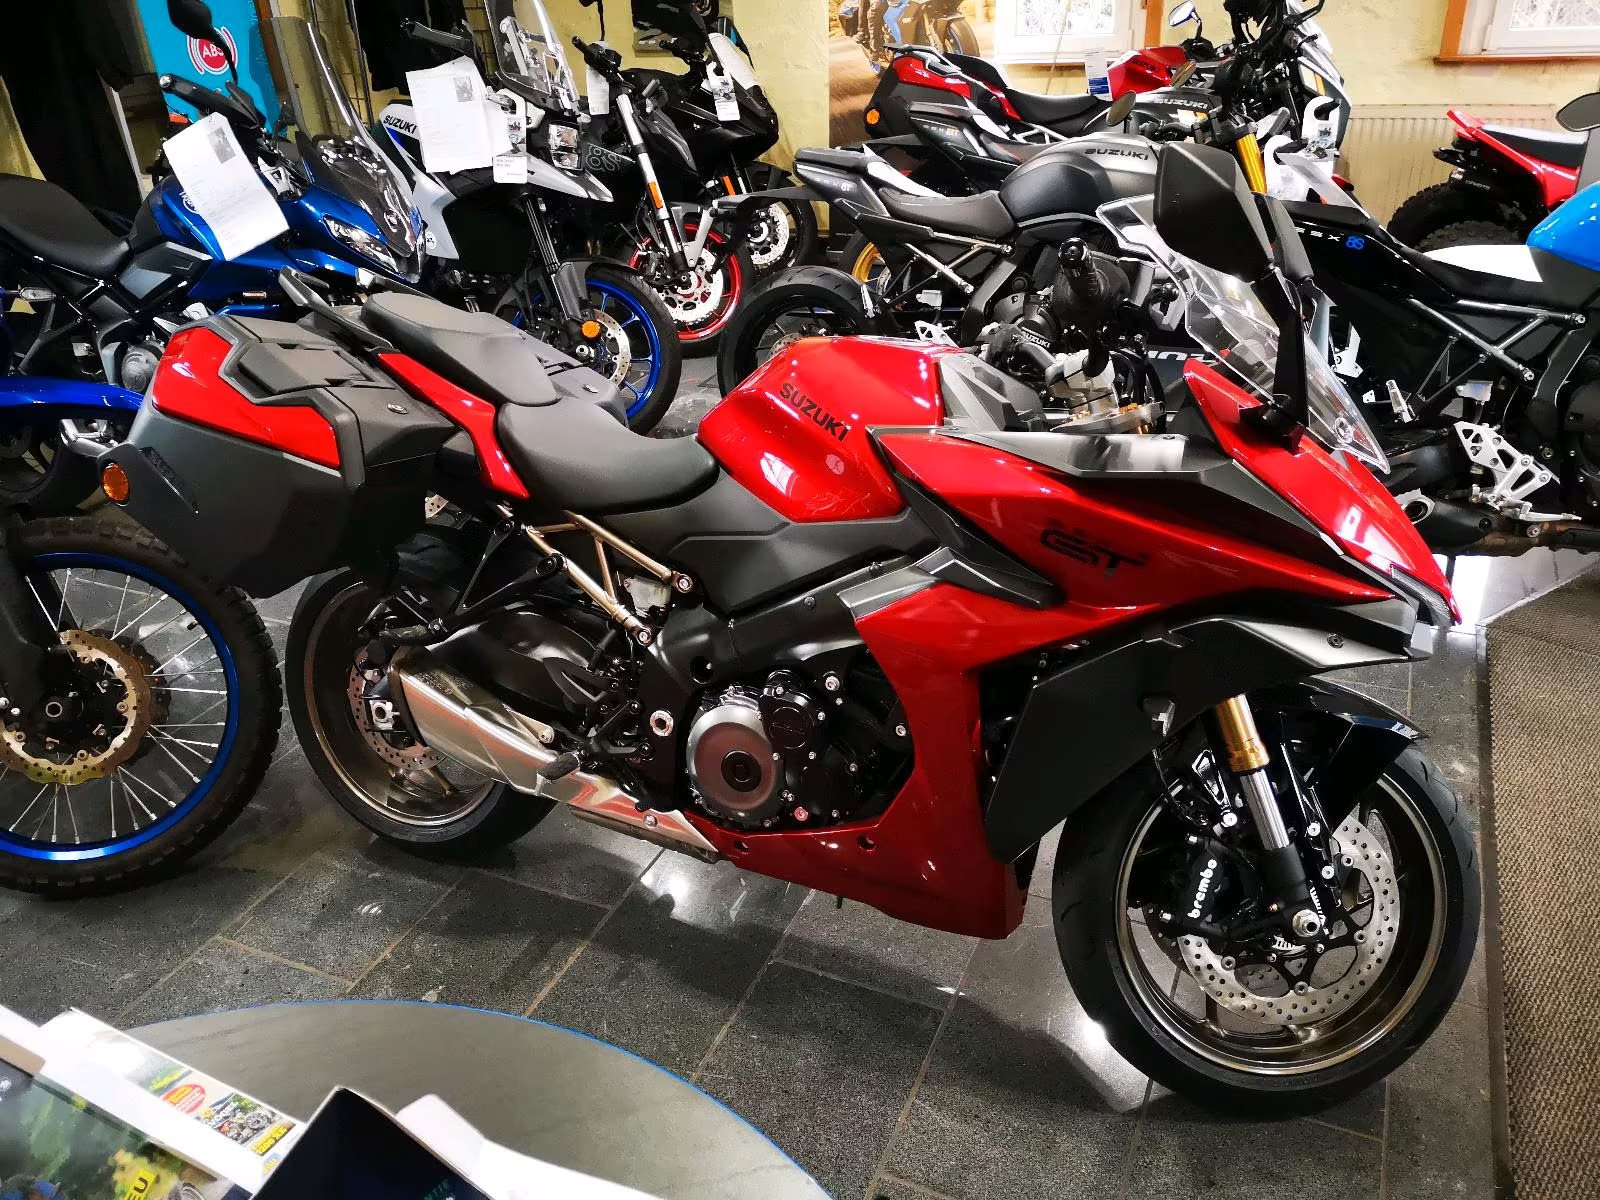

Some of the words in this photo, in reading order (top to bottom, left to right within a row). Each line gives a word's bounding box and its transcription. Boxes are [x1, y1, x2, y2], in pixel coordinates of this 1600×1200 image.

[1153, 98, 1209, 110] SUZUKI
[383, 114, 418, 135] SUZUKI
[1084, 148, 1150, 161] SUZUKI
[779, 382, 852, 442] SUZUKI
[1187, 858, 1218, 919] brembo
